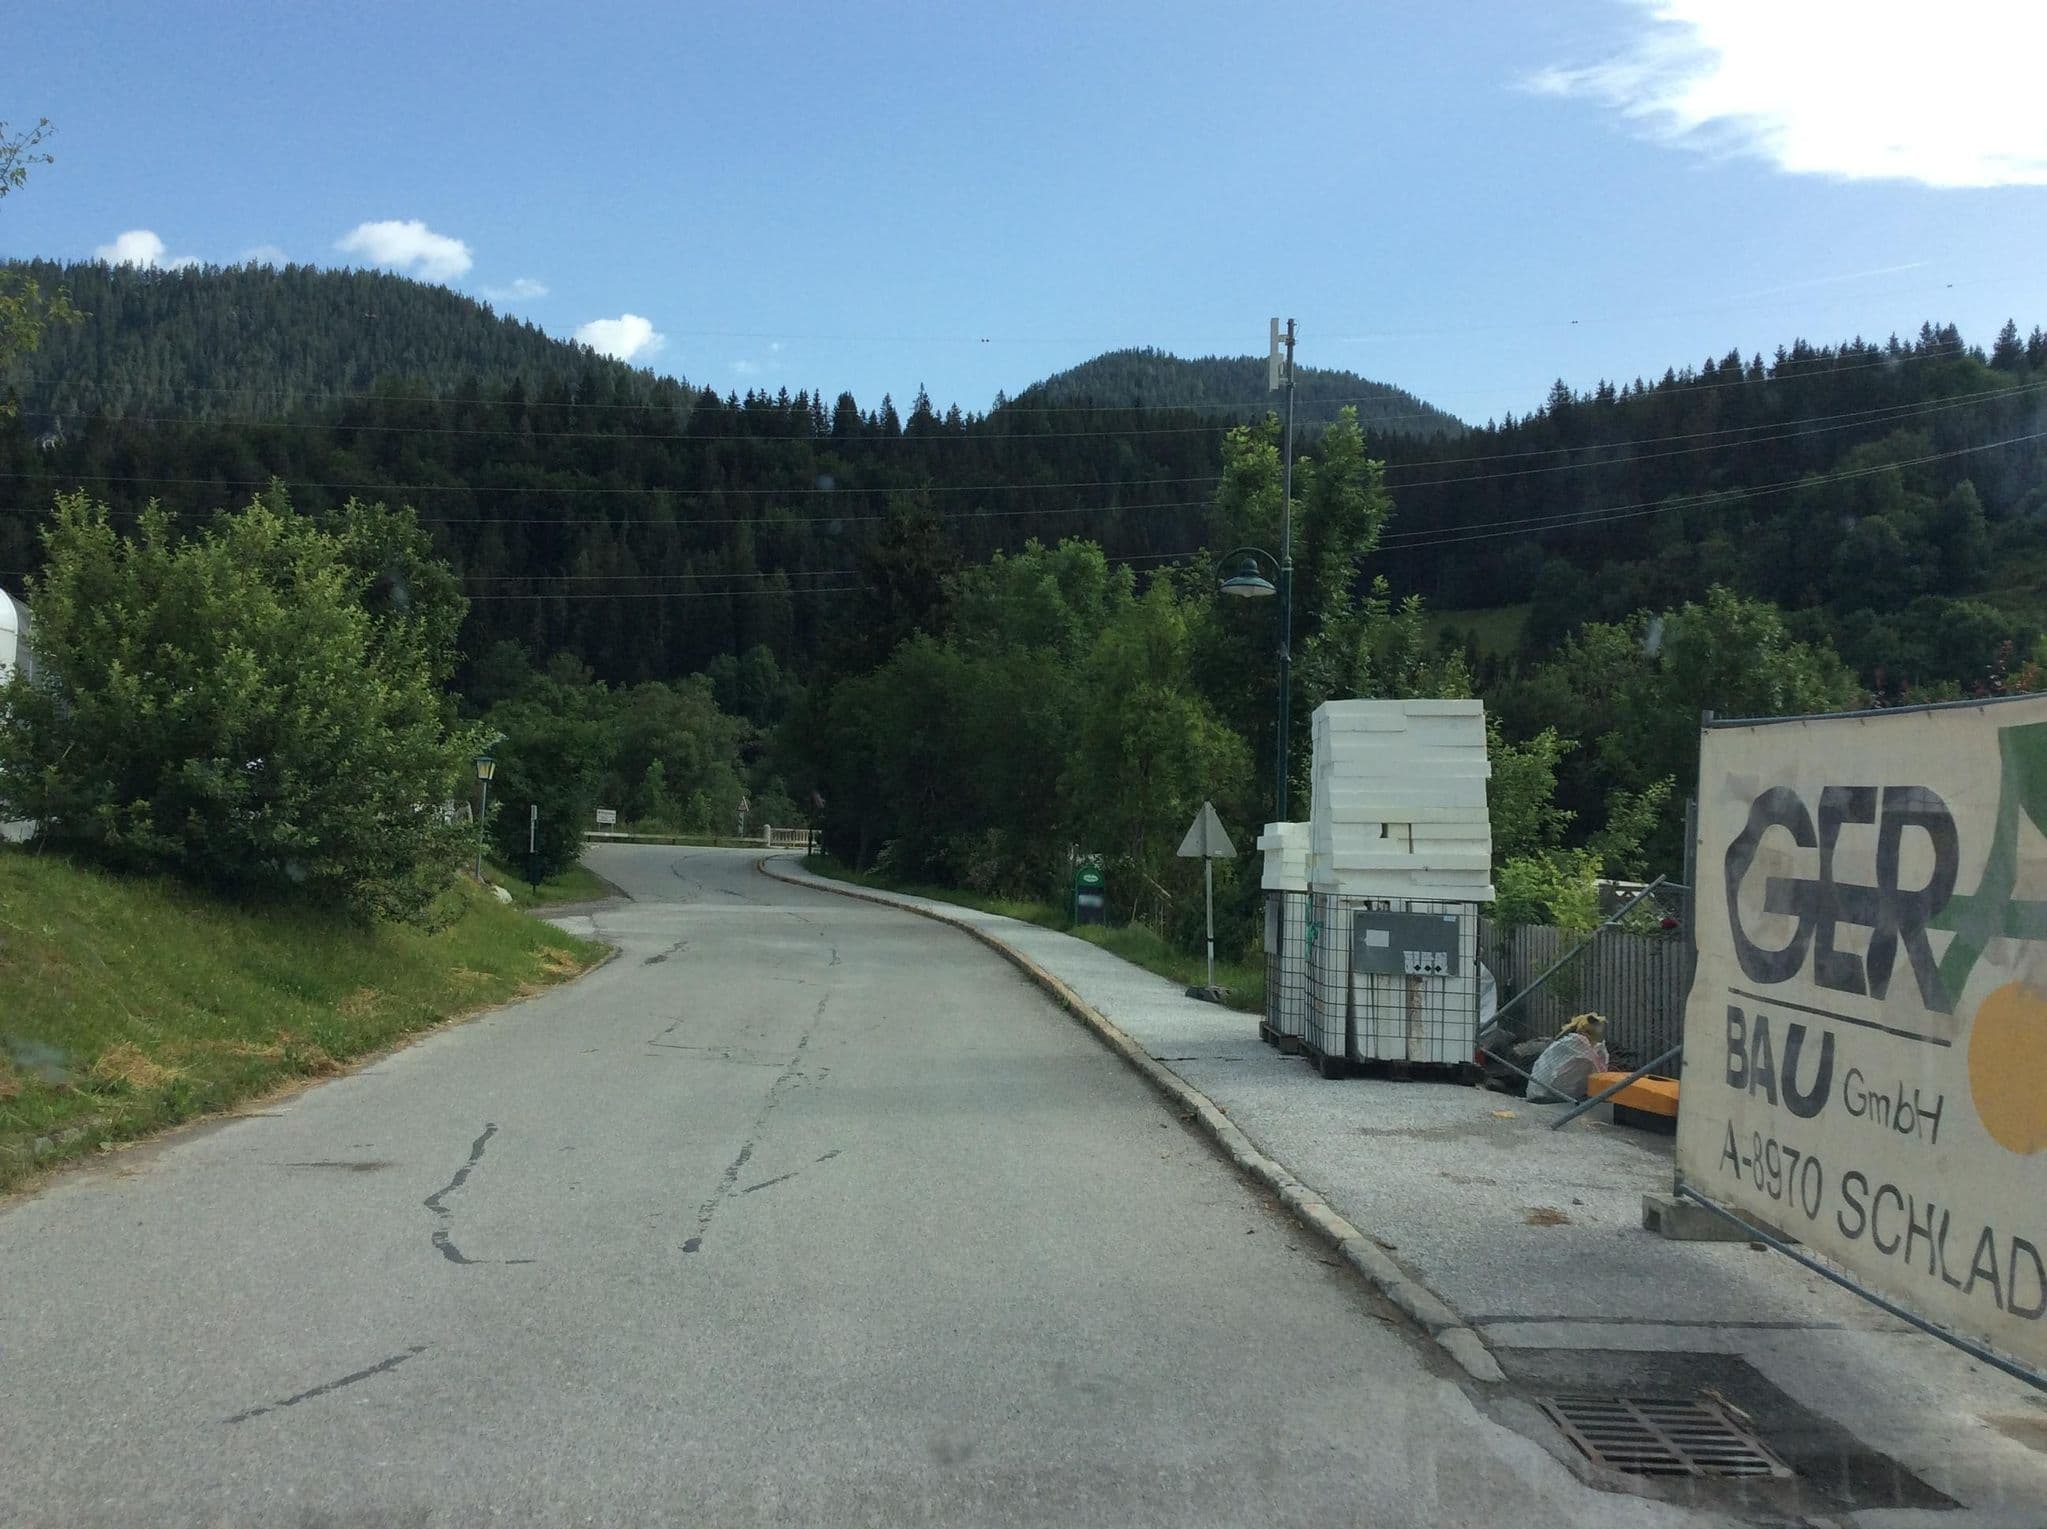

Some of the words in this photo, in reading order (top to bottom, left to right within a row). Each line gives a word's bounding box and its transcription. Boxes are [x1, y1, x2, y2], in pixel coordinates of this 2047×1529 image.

[1724, 786, 1959, 1016] GER
[1726, 1005, 1835, 1119] BAU
[1843, 1067, 1944, 1145] GmbH
[1719, 1119, 1823, 1221] A-8970
[1837, 1170, 2047, 1321] SCHLAD
